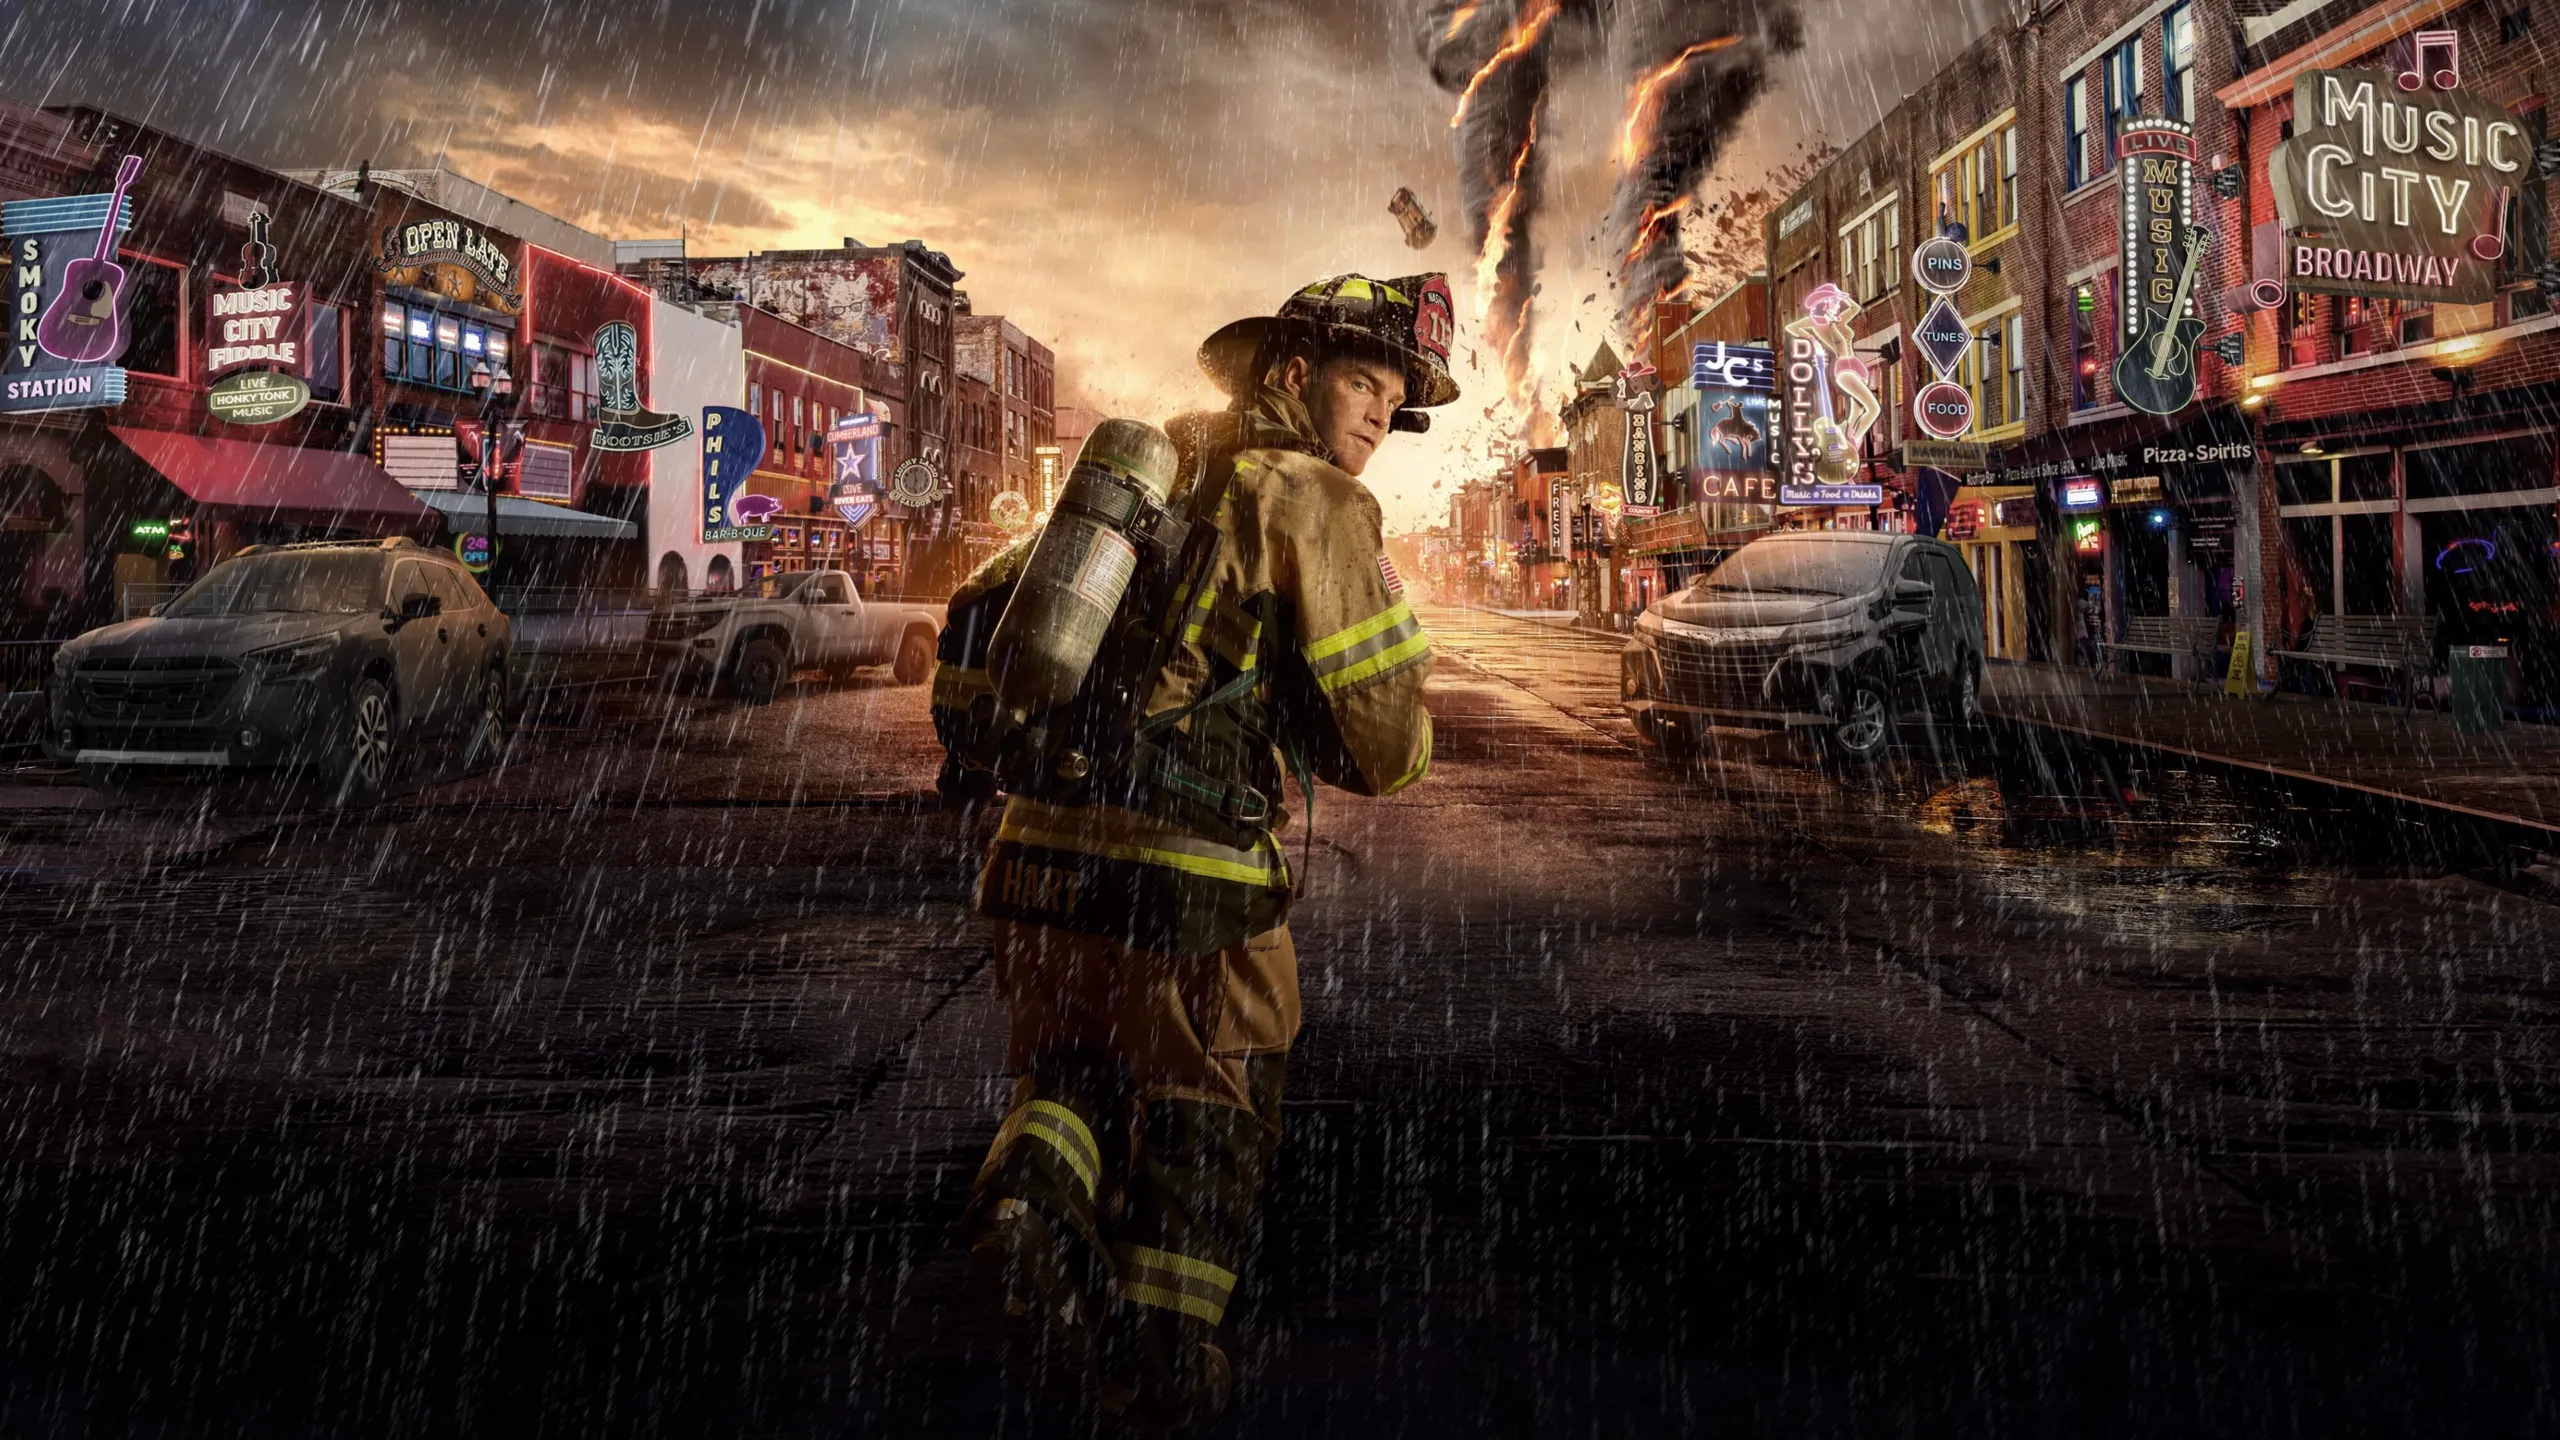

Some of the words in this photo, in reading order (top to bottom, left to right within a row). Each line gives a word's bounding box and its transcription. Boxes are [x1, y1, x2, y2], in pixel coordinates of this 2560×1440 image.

[2325, 76, 2519, 173] MUSIC
[2131, 134, 2190, 154] LIVE
[2308, 144, 2470, 234] CITY
[2143, 159, 2178, 303] MUSIC
[406, 221, 459, 255] OPEN
[465, 228, 508, 283] LATE
[1928, 257, 1963, 270] PINS
[2297, 246, 2459, 286] BROADWAY
[18, 239, 42, 368] SMOKY
[213, 288, 292, 316] MUSIC
[224, 316, 281, 342] CITY
[1925, 331, 1965, 342] TUNES
[209, 342, 295, 371] FIDDLE
[8, 376, 92, 399] STATION
[240, 377, 268, 390] LIVE
[217, 395, 257, 405] HONKY
[259, 390, 290, 401] TONK
[1746, 398, 1766, 406] LIVE
[232, 406, 273, 417] MUSIC
[1928, 403, 1967, 416] FOOD
[595, 422, 687, 447] BOOTSIE'S
[827, 425, 878, 442] CUMBERLAND
[1767, 399, 1782, 464] MUSIC
[1632, 414, 1647, 503] DANCING
[2143, 447, 2187, 463] Pizza
[2196, 442, 2252, 461] Spirits
[705, 413, 723, 523] PHILS
[895, 457, 917, 478] LUCKY
[919, 458, 939, 478] LASSO
[843, 483, 863, 495] COVE
[1703, 475, 1776, 499] CAFE
[1786, 490, 1812, 499] Music
[1820, 489, 1841, 499] Food
[1850, 490, 1878, 499] Drinks
[834, 497, 855, 505] RIVER
[856, 495, 874, 503] EATS
[900, 496, 931, 508] SALOON
[1552, 483, 1561, 548] FRESH
[1628, 507, 1655, 516] COUNTRY
[135, 526, 166, 534] ATM
[705, 527, 766, 541] BAR-B-QUE
[1002, 860, 1082, 915] HART
